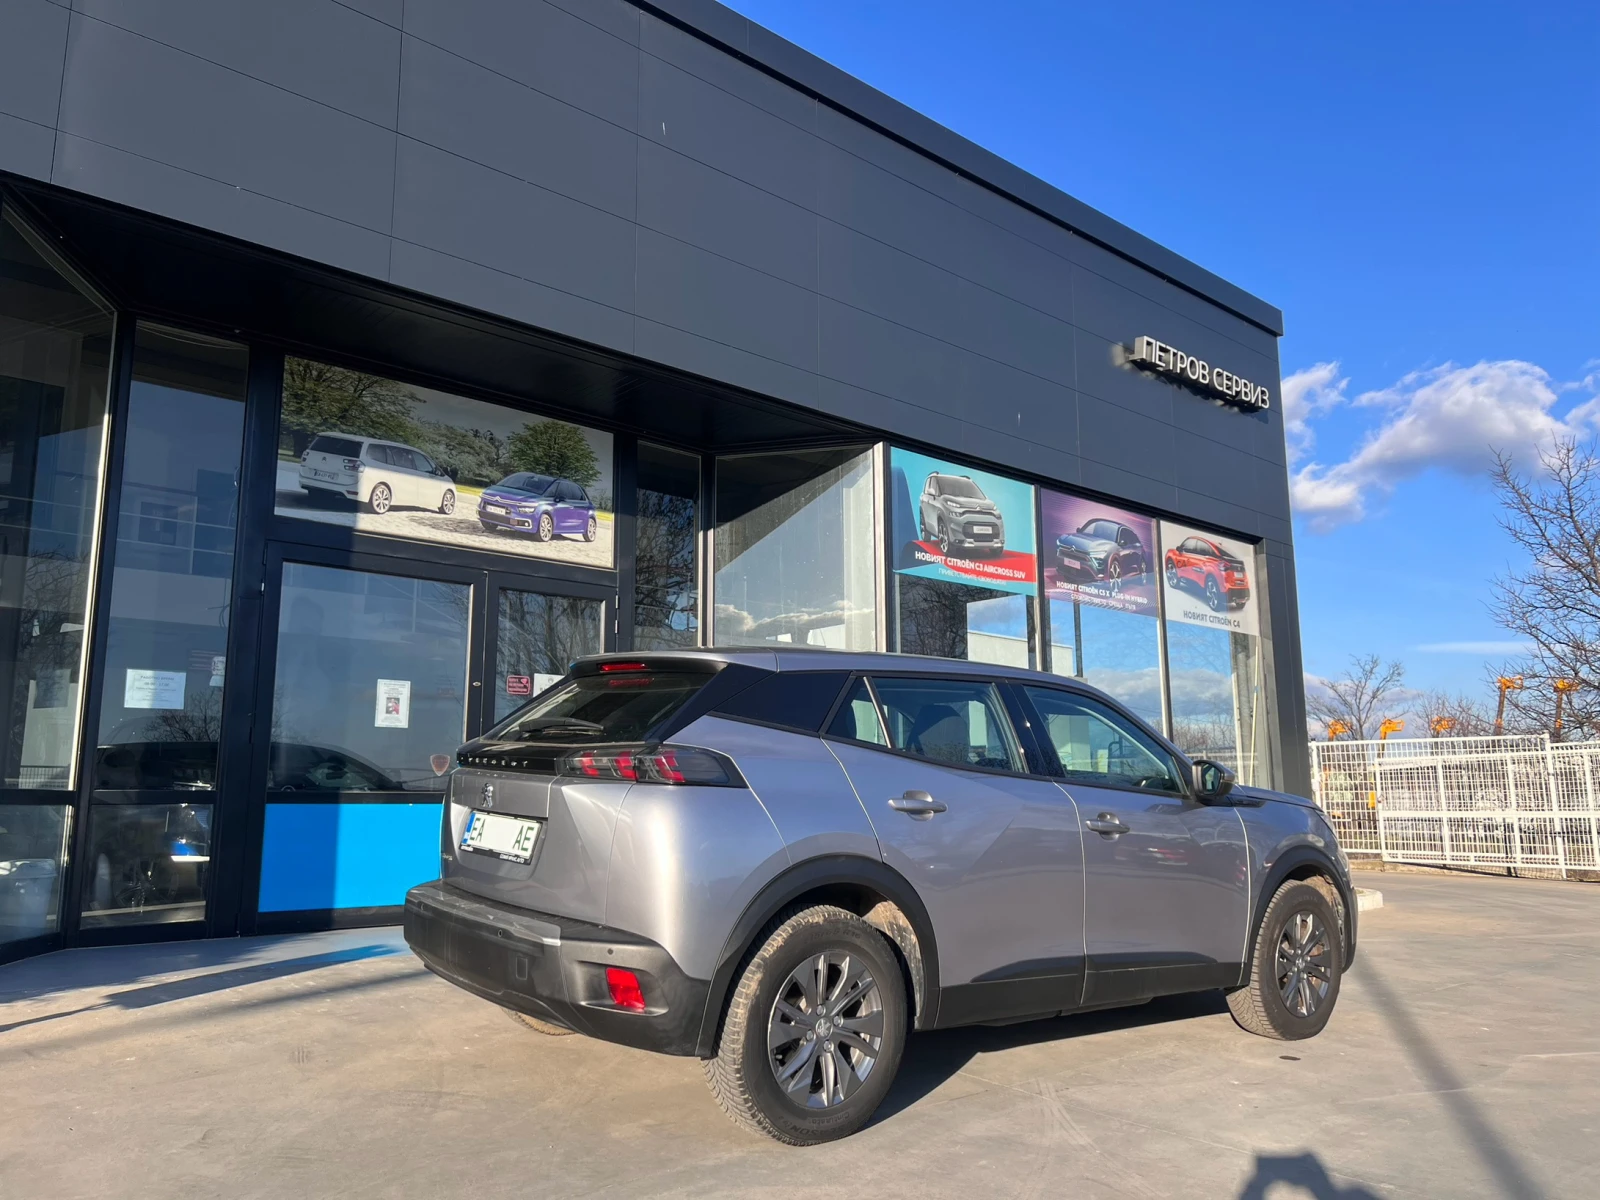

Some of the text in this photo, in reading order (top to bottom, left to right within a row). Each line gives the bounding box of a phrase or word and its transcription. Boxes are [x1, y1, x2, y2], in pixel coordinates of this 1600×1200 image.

[1143, 335, 1270, 409] ПЕТРОВ СЕРВИЗ
[915, 551, 1026, 579] НОВИЯТ CITROËN C3 AIRCROSS SUV
[1056, 581, 1078, 591] НОВИЯТ
[1078, 584, 1098, 595] CITROËN
[1106, 589, 1110, 597] X
[1183, 610, 1208, 622] НОВИЯТ
[1209, 615, 1232, 627] CITROËN
[469, 817, 535, 852] EA AE
